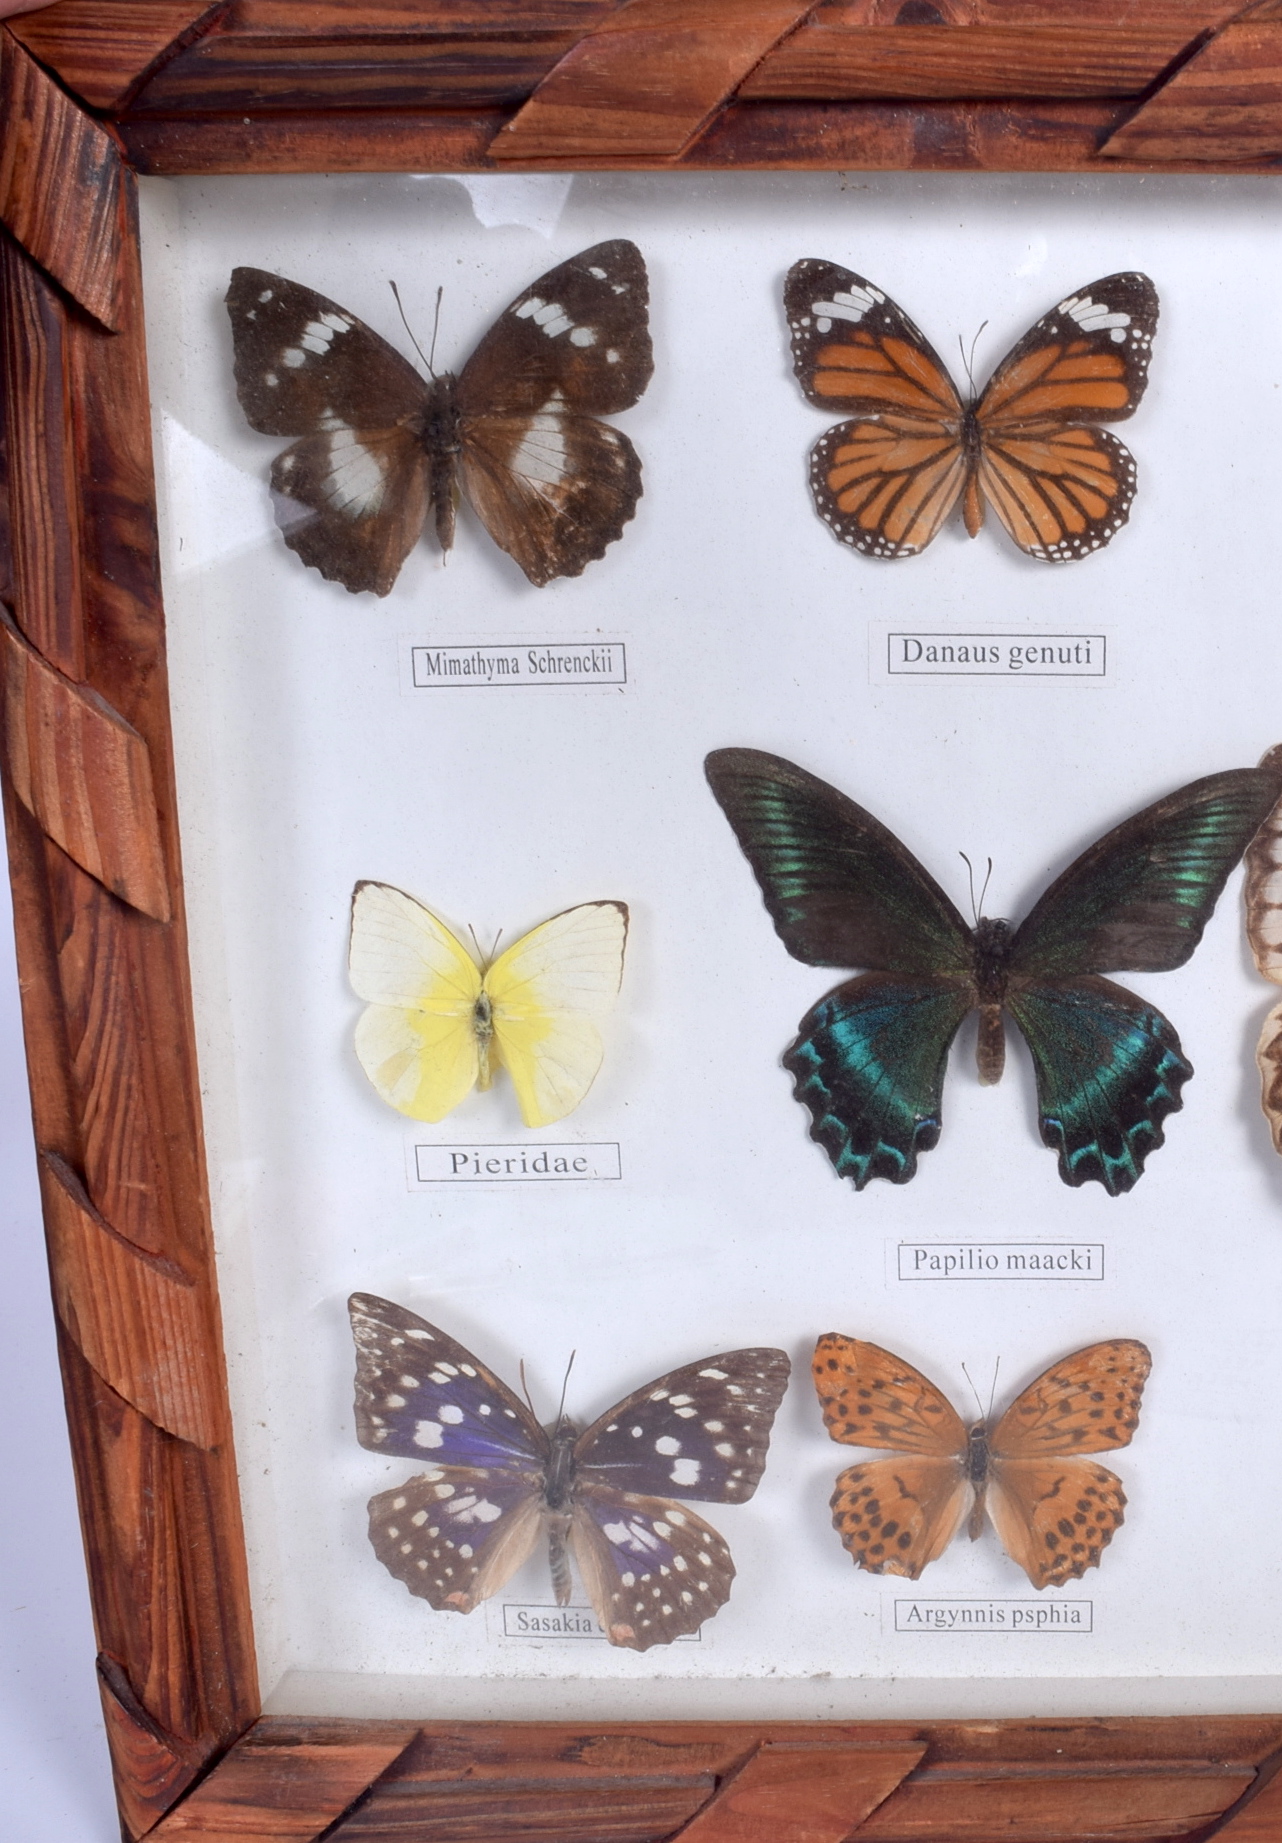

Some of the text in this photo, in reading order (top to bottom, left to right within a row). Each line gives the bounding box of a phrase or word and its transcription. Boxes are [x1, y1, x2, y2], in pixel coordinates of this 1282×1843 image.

[426, 649, 612, 681] Mimathyma Schrenckii
[902, 638, 1092, 670] Danaus genuti
[449, 1152, 588, 1176] Pieridae
[914, 1248, 1092, 1275] Papilio maacki
[517, 1611, 591, 1633] Sasakia
[906, 1604, 1081, 1628] Argynnis psphia
